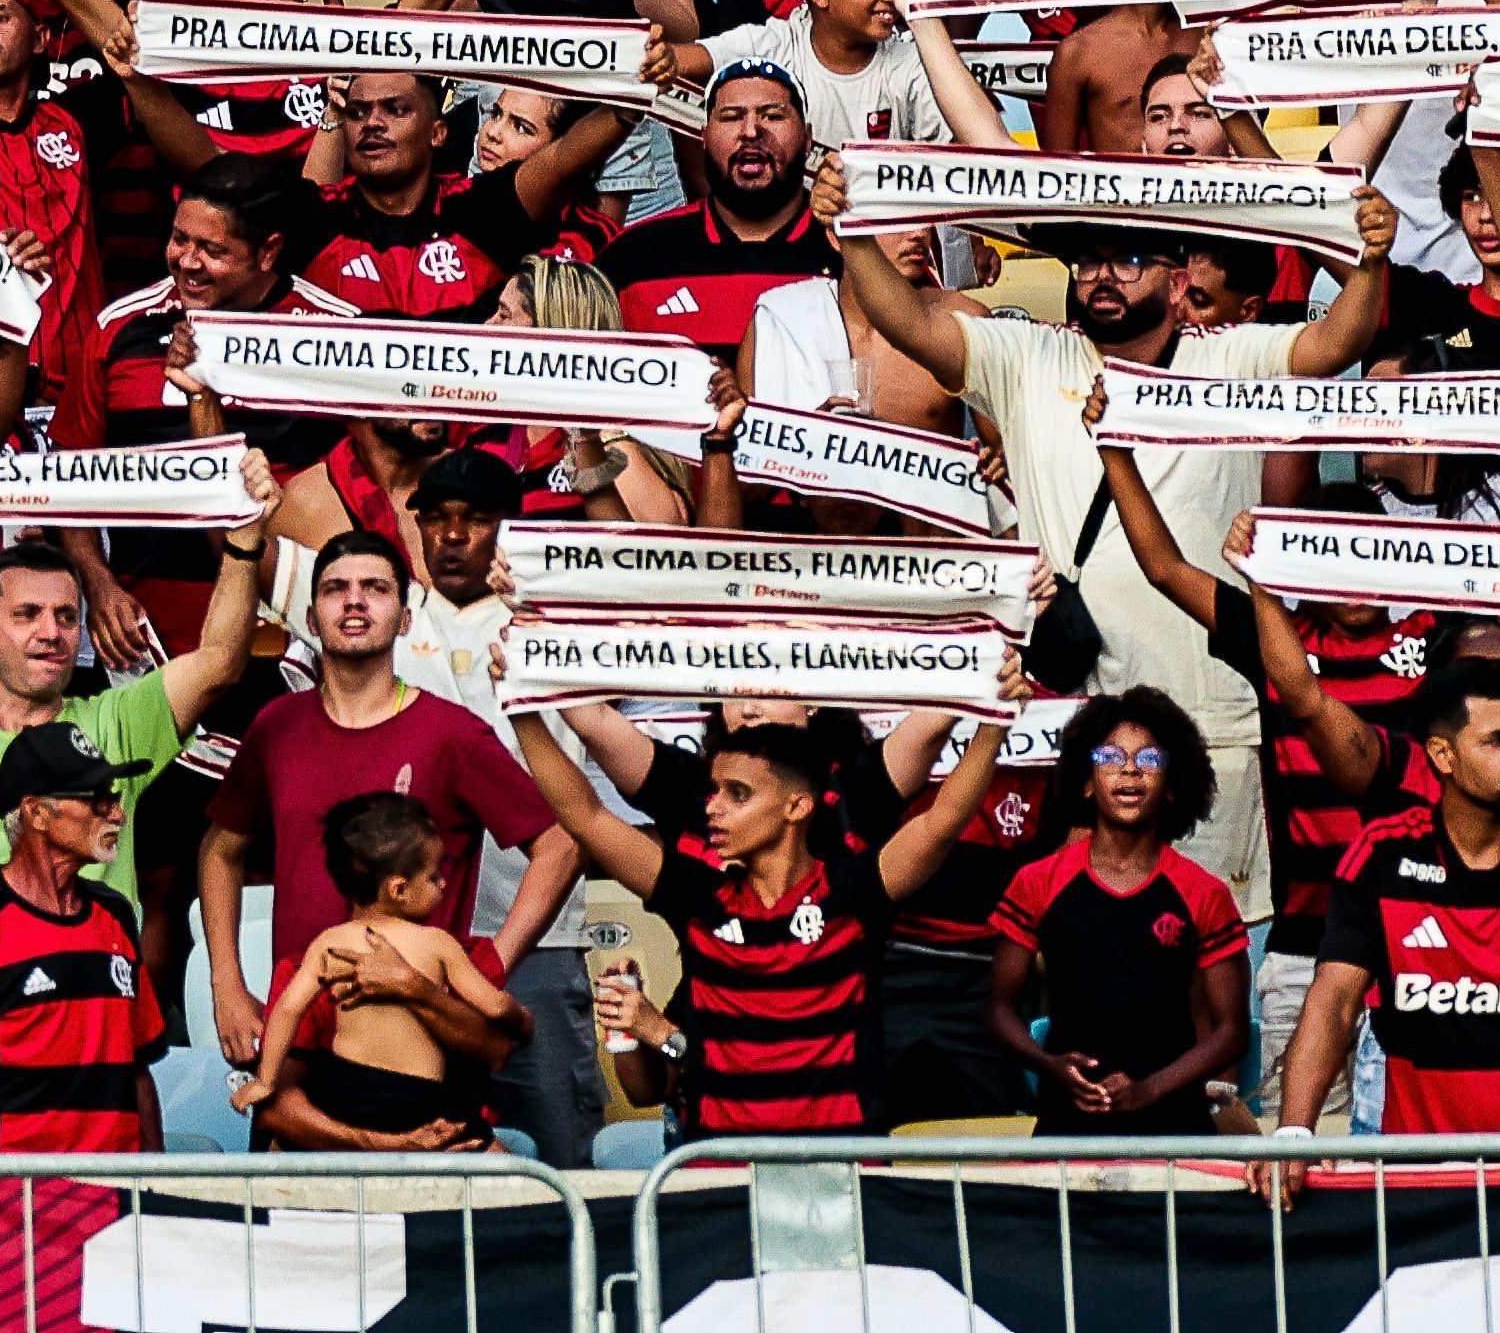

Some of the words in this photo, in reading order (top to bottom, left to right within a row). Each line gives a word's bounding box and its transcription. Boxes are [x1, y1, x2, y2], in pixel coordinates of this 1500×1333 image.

[172, 15, 227, 48] PRA
[238, 22, 319, 52] CIMA
[329, 29, 421, 64] DELES,
[432, 33, 616, 71] FLAMENGO!
[224, 337, 281, 364] PRA
[293, 340, 374, 368] CIMA
[386, 343, 478, 377] DELES,
[490, 350, 676, 387] FLAMENGO!
[431, 386, 497, 402] Betano
